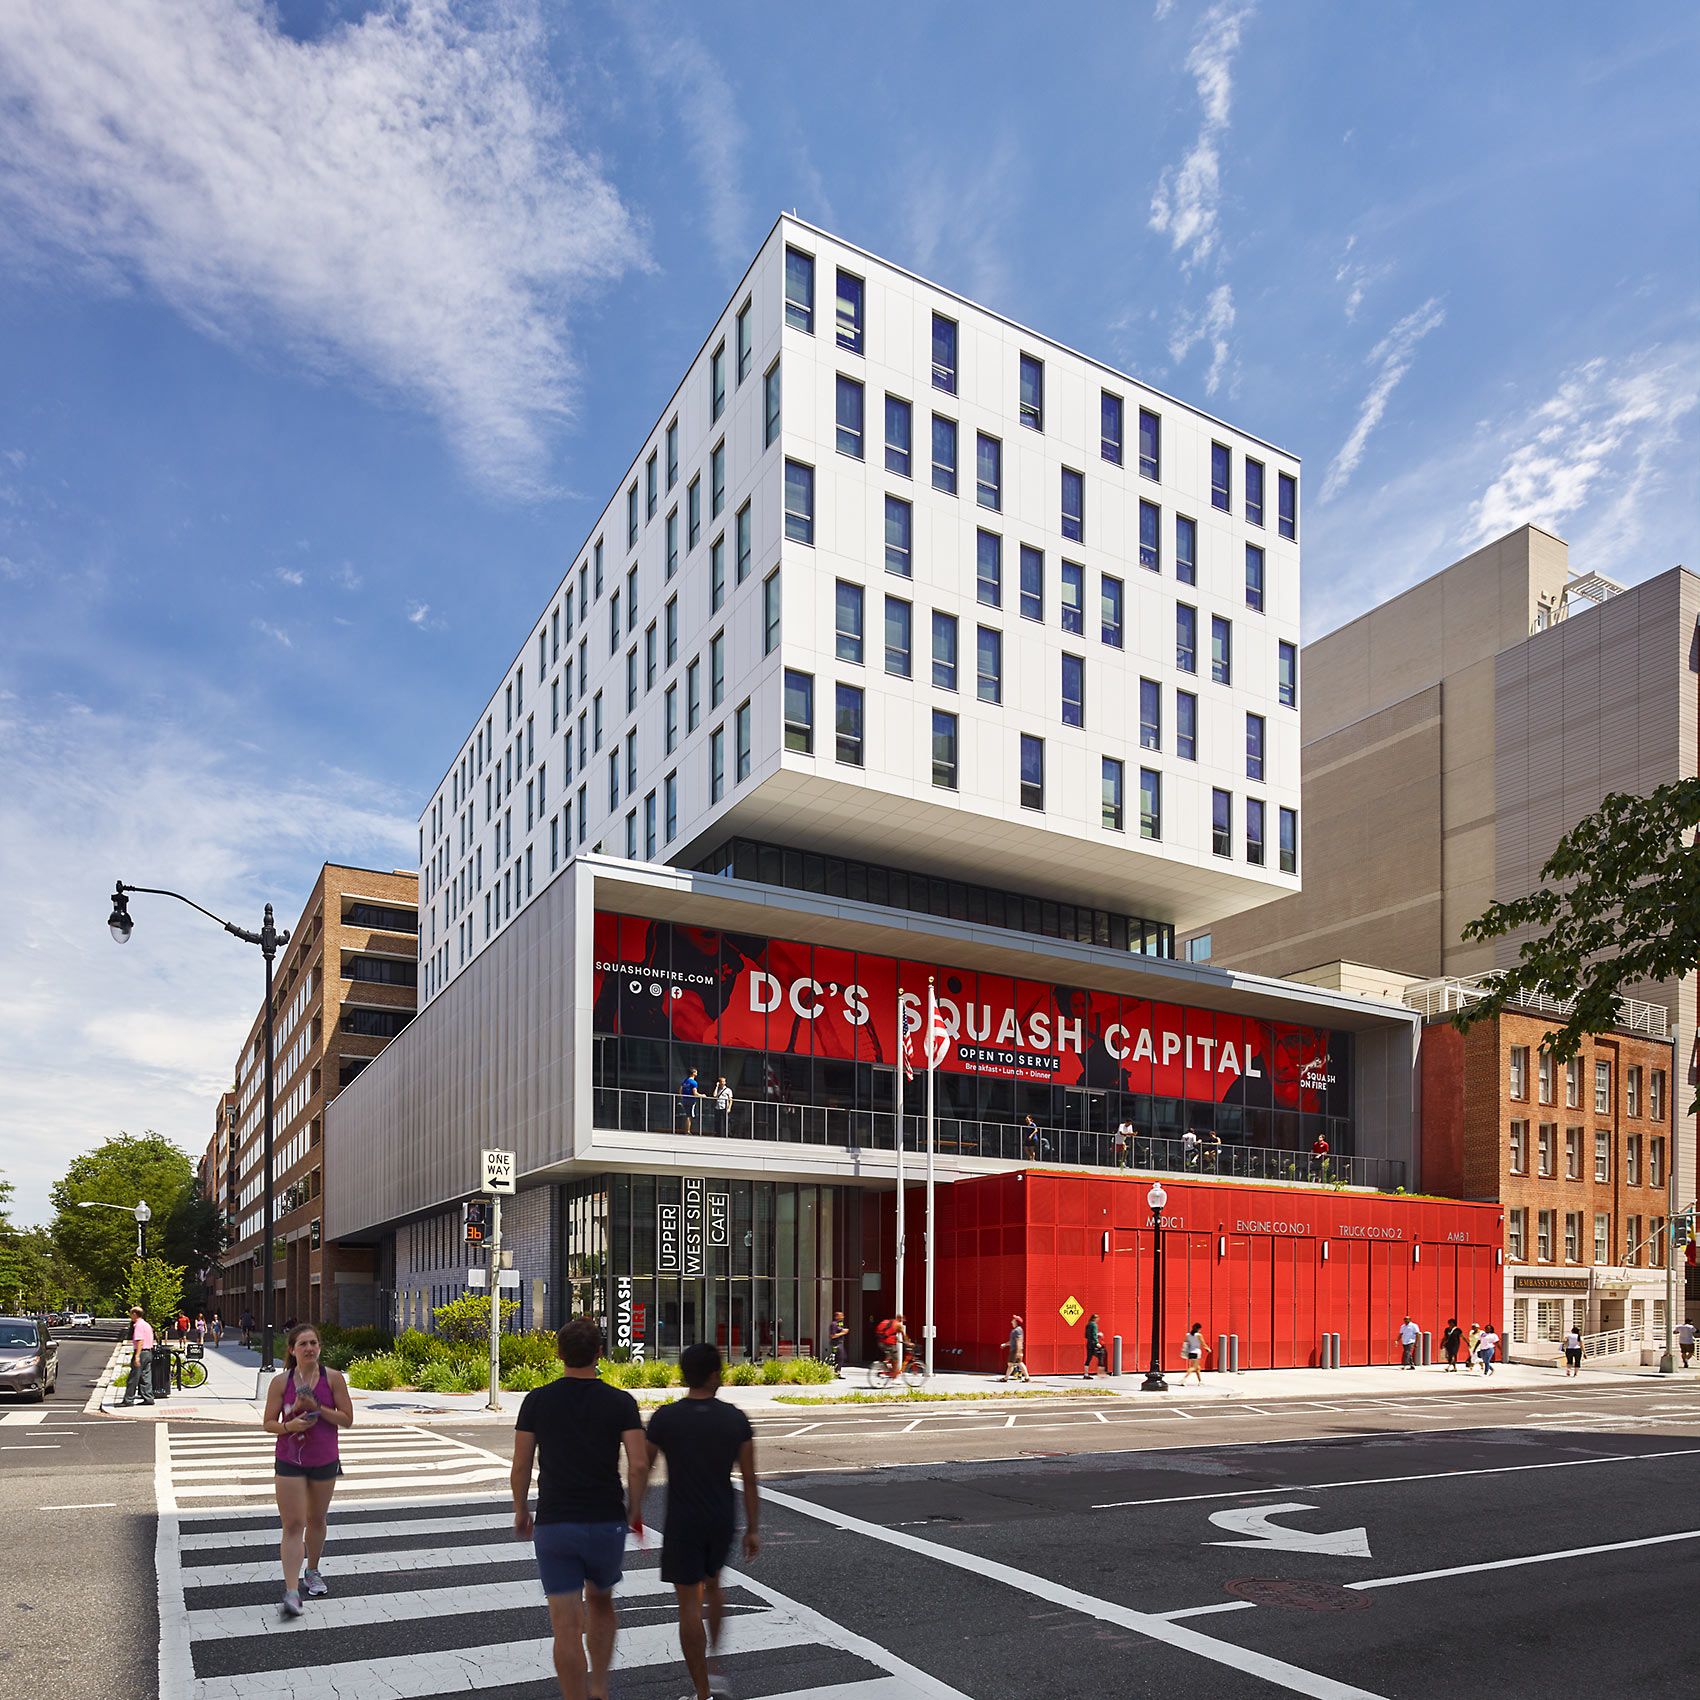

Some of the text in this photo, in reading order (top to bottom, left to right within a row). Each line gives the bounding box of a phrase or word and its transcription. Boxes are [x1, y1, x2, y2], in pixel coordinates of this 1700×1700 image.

[595, 961, 714, 985] SQUASHONFIRE.COM
[900, 992, 1082, 1054] SQUASH
[1104, 1023, 1262, 1078] CAPITAL
[960, 1047, 1059, 1069] OPEN TO SERVE
[965, 1062, 1051, 1079] Breakfast Lunch Dinner
[1306, 1072, 1336, 1083] SQUASH
[1300, 1080, 1327, 1090] ON FIRE
[488, 1153, 510, 1165] ONE
[487, 1165, 511, 1176] WAY
[708, 1196, 725, 1242] CAFÉ
[1146, 1216, 1178, 1229] MDIC
[467, 1226, 482, 1239] 36
[686, 1179, 701, 1274] WEST SIDE
[1236, 1220, 1271, 1233] ENGINE
[1273, 1221, 1288, 1233] CO
[1289, 1223, 1305, 1234] NO
[1339, 1225, 1403, 1239] TRUCK CO NO 2
[662, 1207, 677, 1267] UPPER
[1447, 1231, 1465, 1242] AMB
[1519, 1279, 1548, 1287] EMBASSY
[1559, 1280, 1588, 1288] SENEGAL
[617, 1277, 631, 1348] SQUASH
[632, 1302, 645, 1365] ON FIRE
